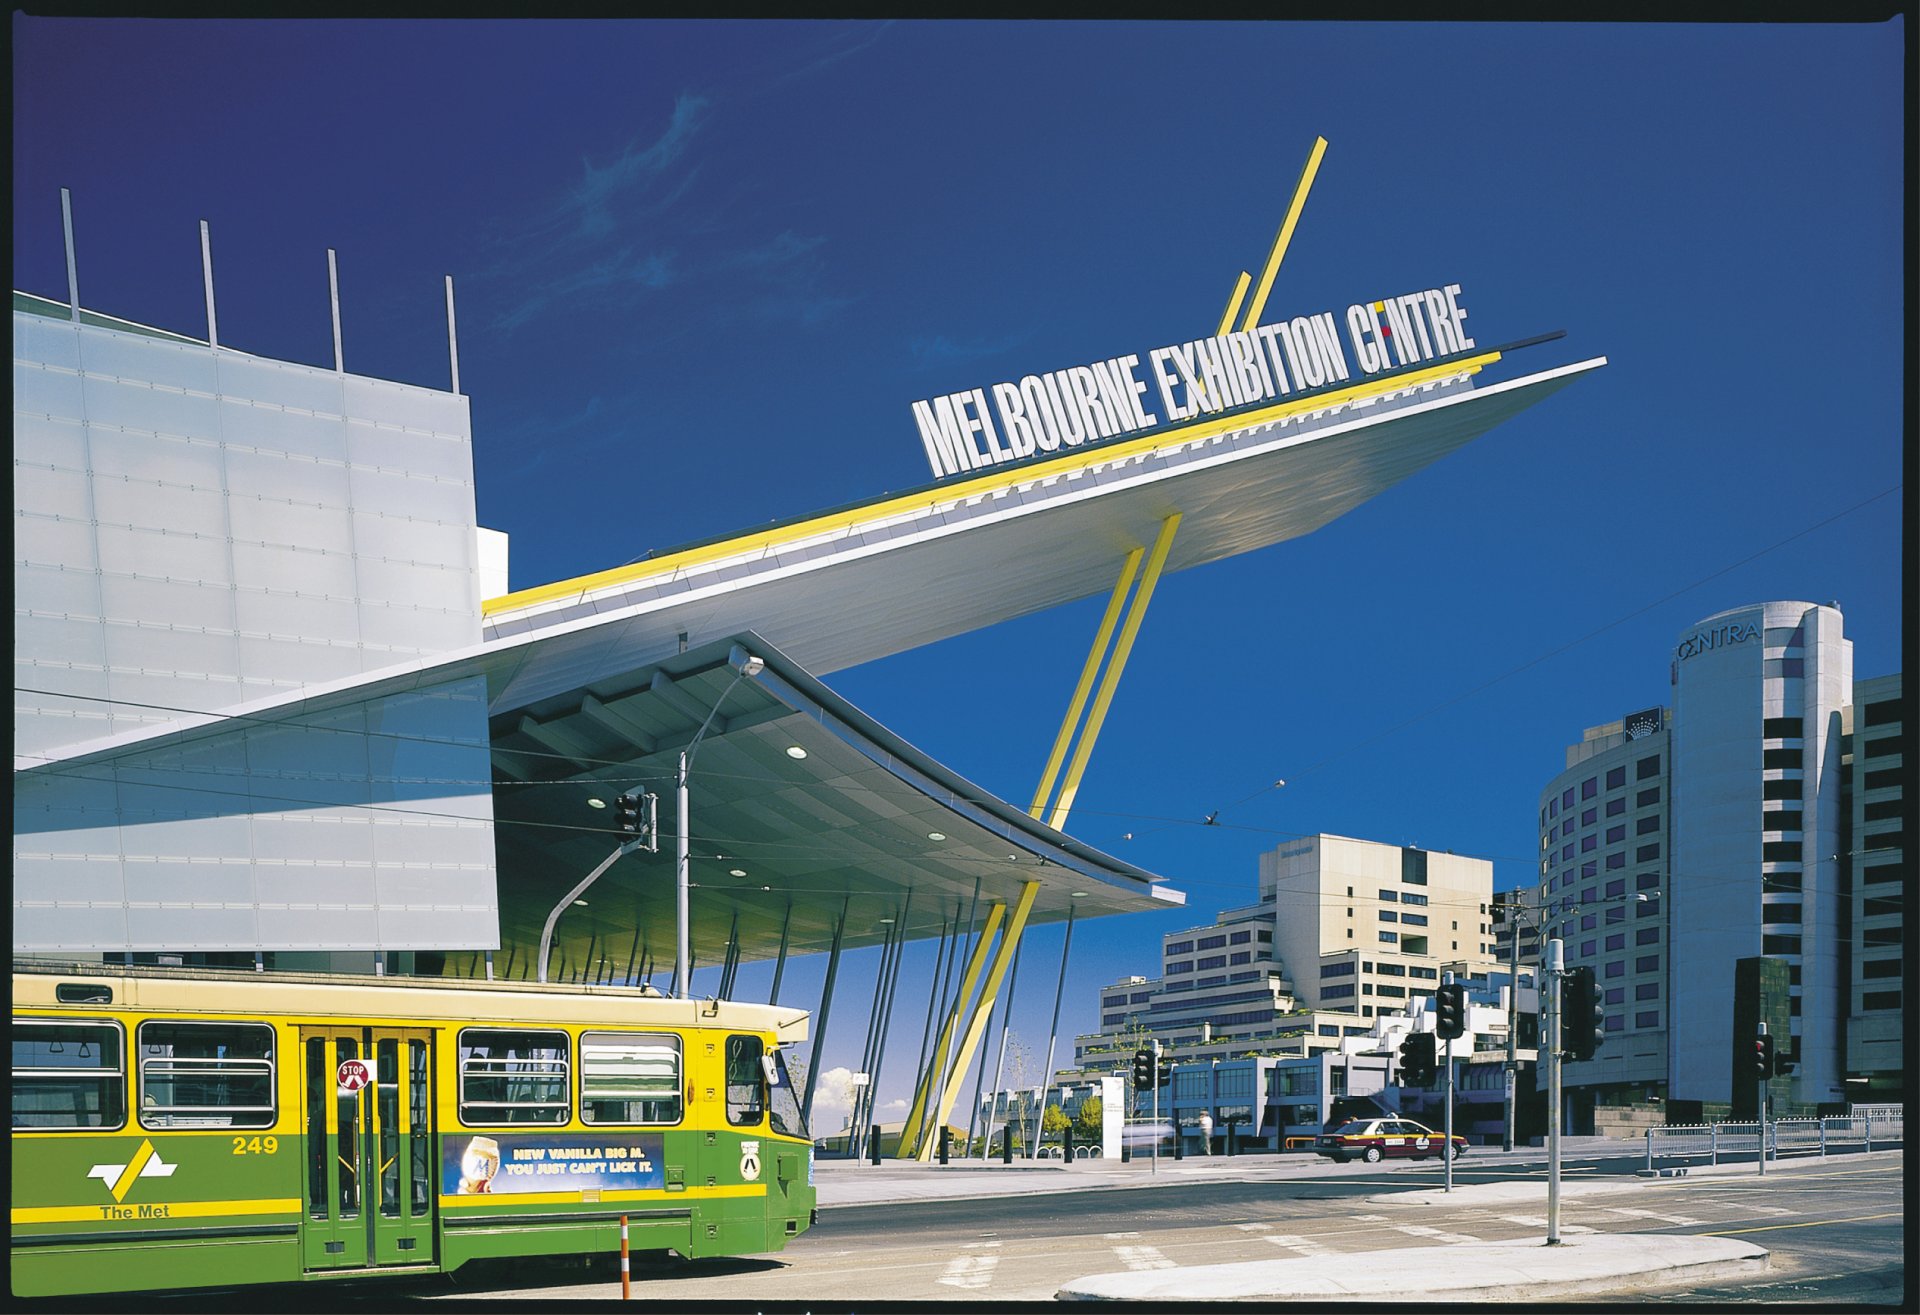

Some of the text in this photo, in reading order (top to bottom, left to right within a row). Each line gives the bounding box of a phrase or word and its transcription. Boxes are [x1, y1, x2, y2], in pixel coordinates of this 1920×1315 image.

[911, 283, 1476, 479] MELBOURNE EXHIBITION CENTRE
[1676, 623, 1763, 661] CENTRA
[342, 1065, 365, 1076] STOP
[232, 1136, 279, 1155] 249
[513, 1147, 645, 1161] NEW VANILLA BIG M.
[505, 1161, 653, 1176] YOU JUST CAN'T LICK IT.
[100, 1205, 170, 1219] The Met
